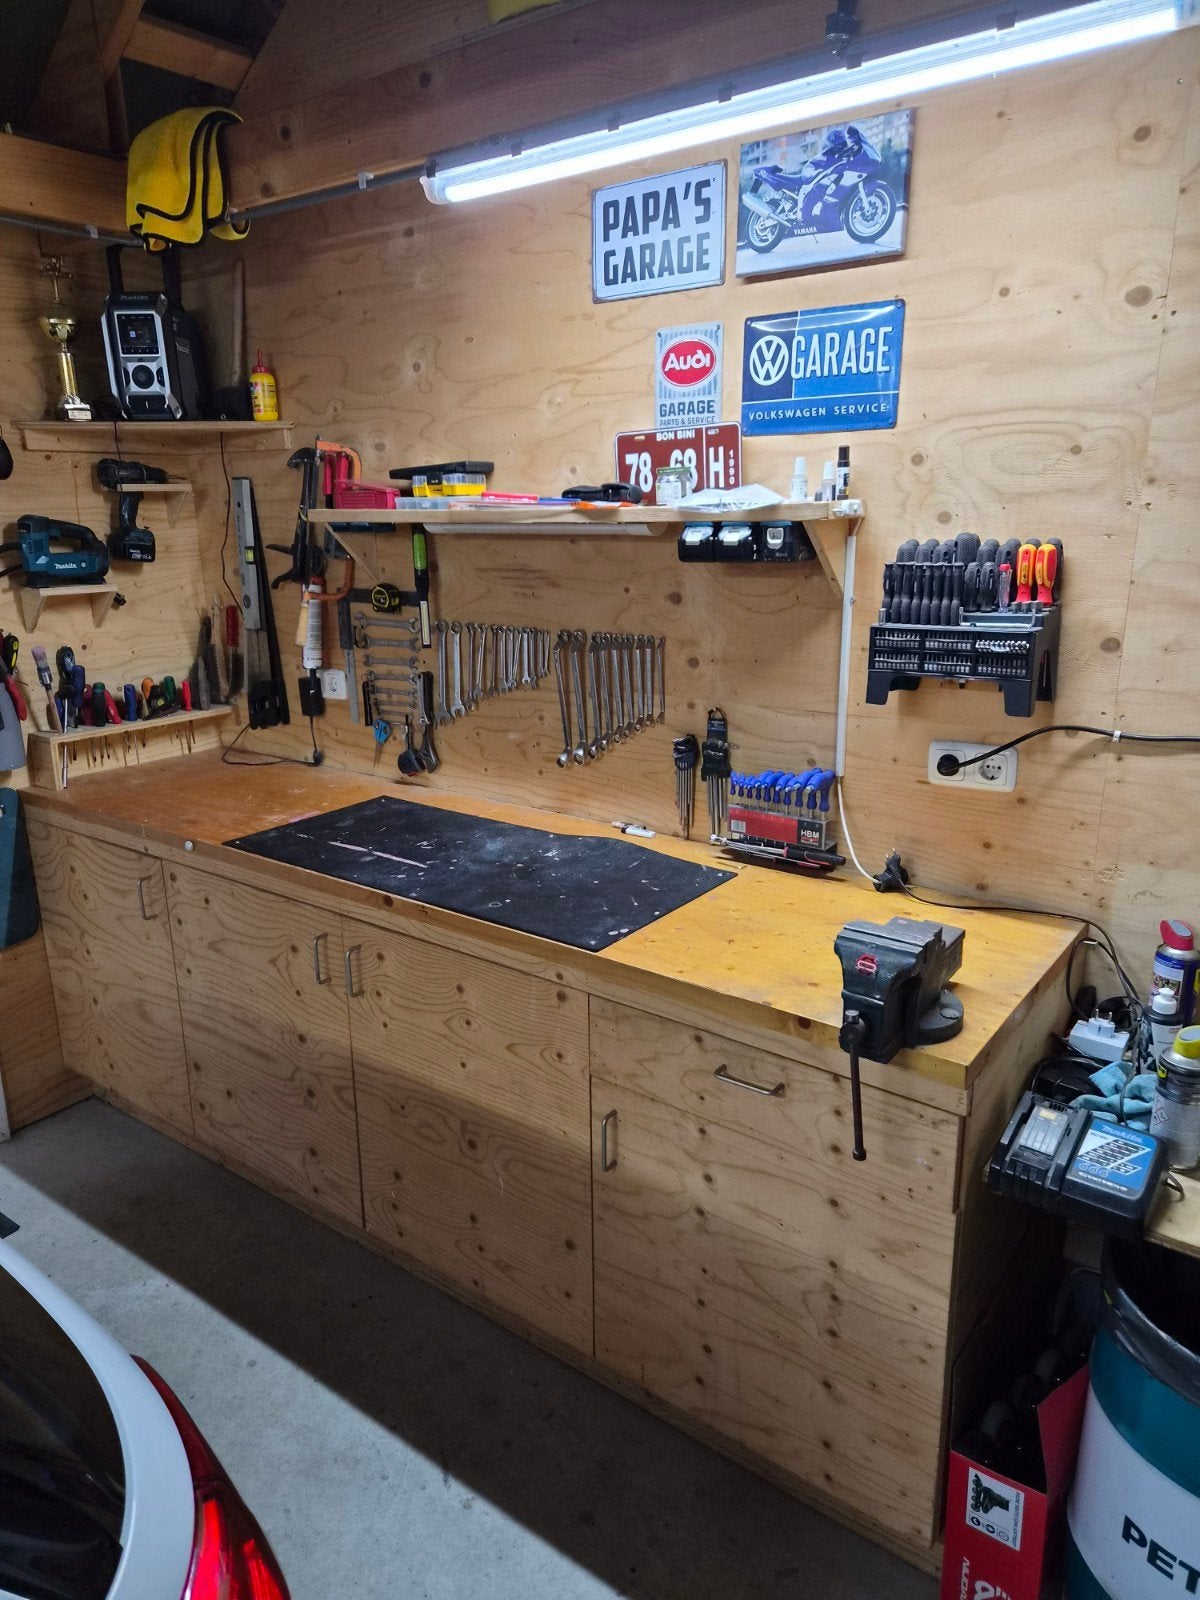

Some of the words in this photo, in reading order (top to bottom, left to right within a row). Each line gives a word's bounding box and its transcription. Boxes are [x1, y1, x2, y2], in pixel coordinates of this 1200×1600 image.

[603, 179, 711, 242] PAPA'S
[793, 226, 817, 236] YAMAHA
[603, 232, 711, 286] GARAGE
[664, 349, 711, 372] Audi
[790, 326, 893, 380] GARAGE
[660, 400, 716, 417] GARAGE
[748, 406, 826, 421] VOLKSWAGEN
[834, 402, 888, 415] SERVICE
[660, 418, 680, 427] PARTS
[688, 416, 716, 424] SERVICE
[656, 431, 675, 441] BON
[677, 429, 695, 439] BINI
[625, 451, 653, 493] 78
[709, 446, 725, 488] H
[800, 829, 820, 839] HBM
[1121, 1514, 1200, 1595] PET
